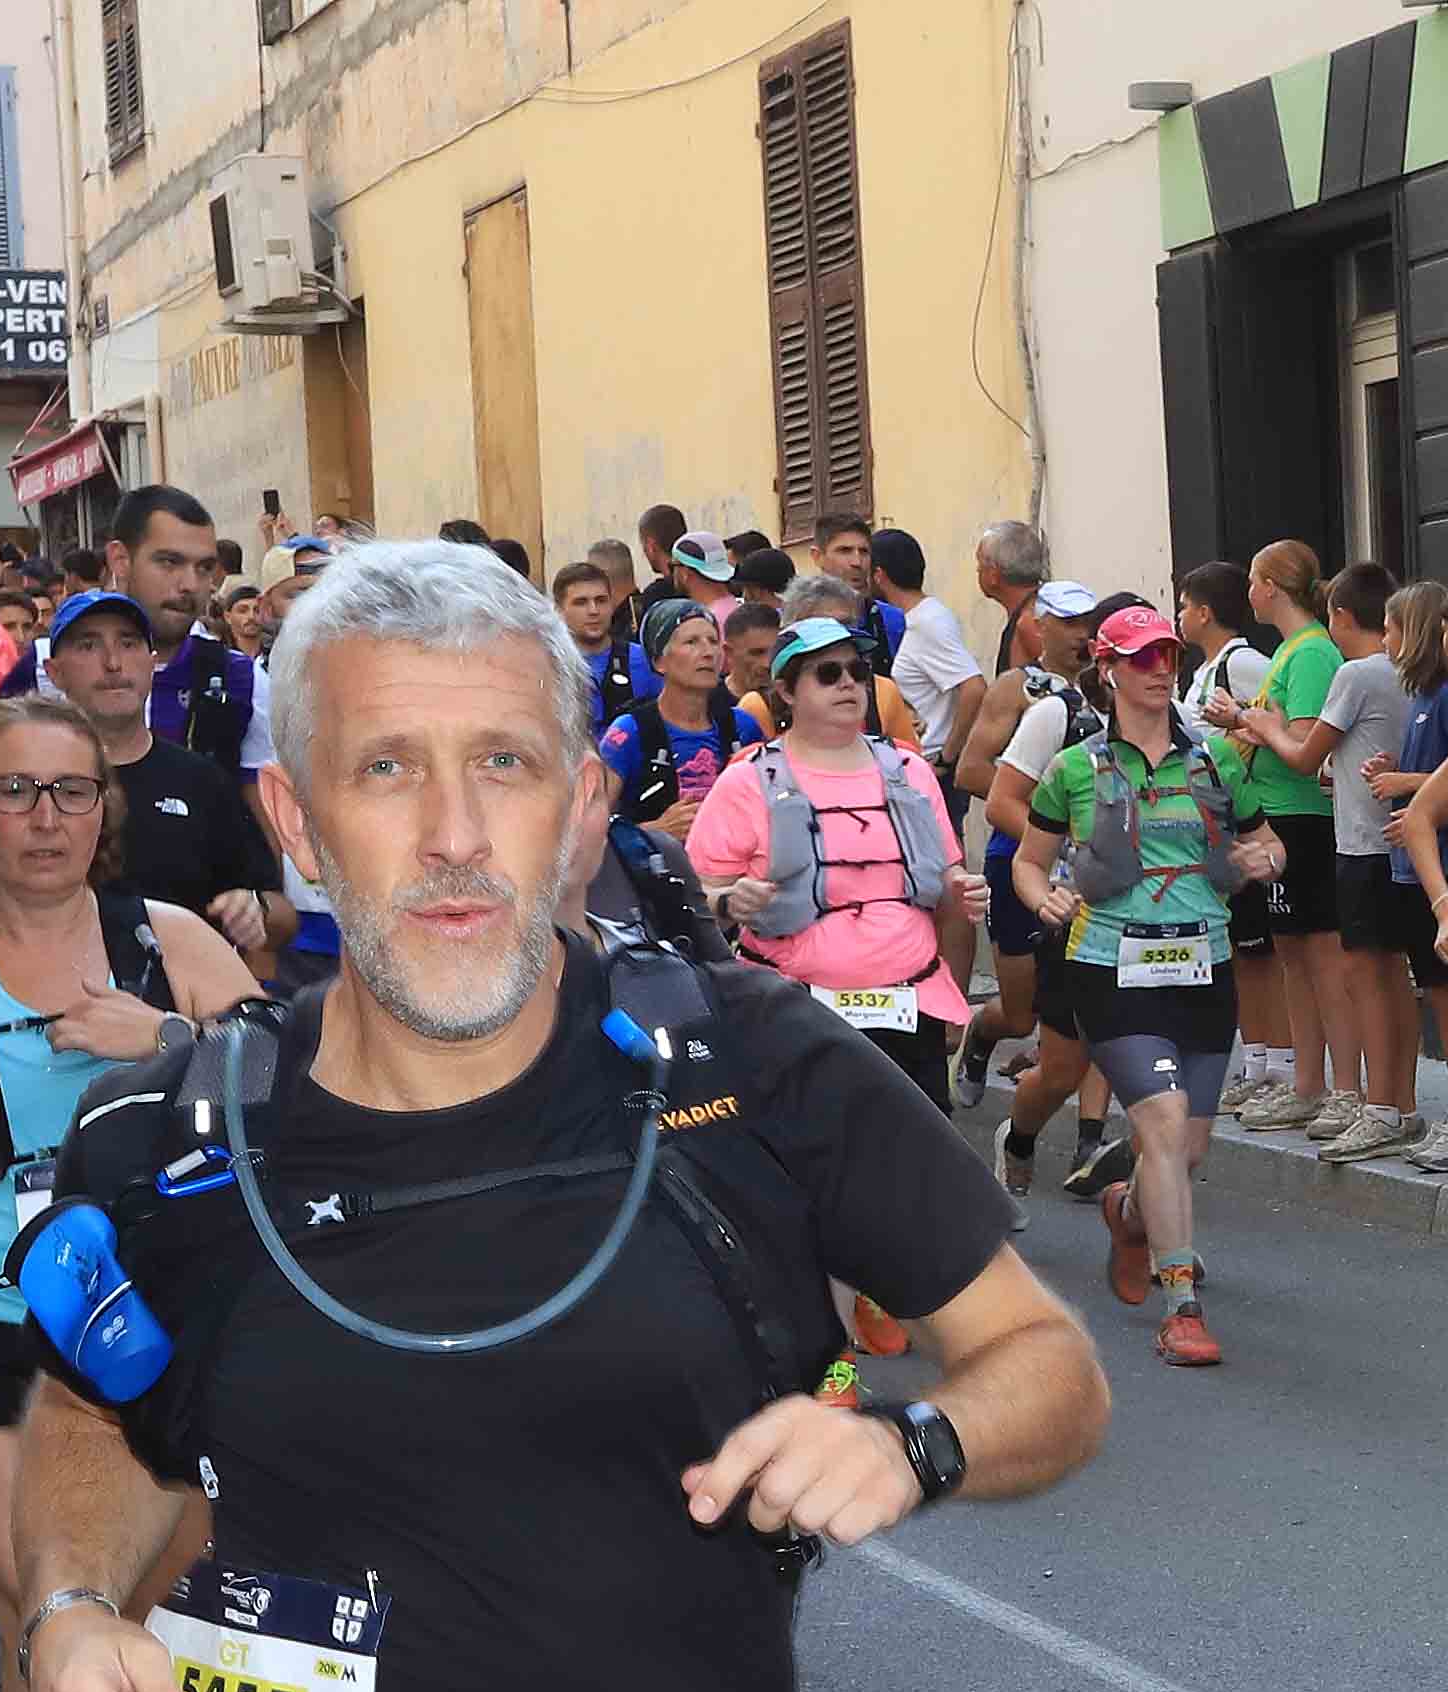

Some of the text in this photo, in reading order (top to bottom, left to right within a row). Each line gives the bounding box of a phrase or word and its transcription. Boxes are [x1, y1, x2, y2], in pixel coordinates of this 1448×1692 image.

[28, 339, 67, 362] 06
[1144, 947, 1190, 963] 5526
[839, 992, 890, 1007] 5537
[219, 1640, 249, 1670] GT
[318, 1661, 337, 1675] 20K
